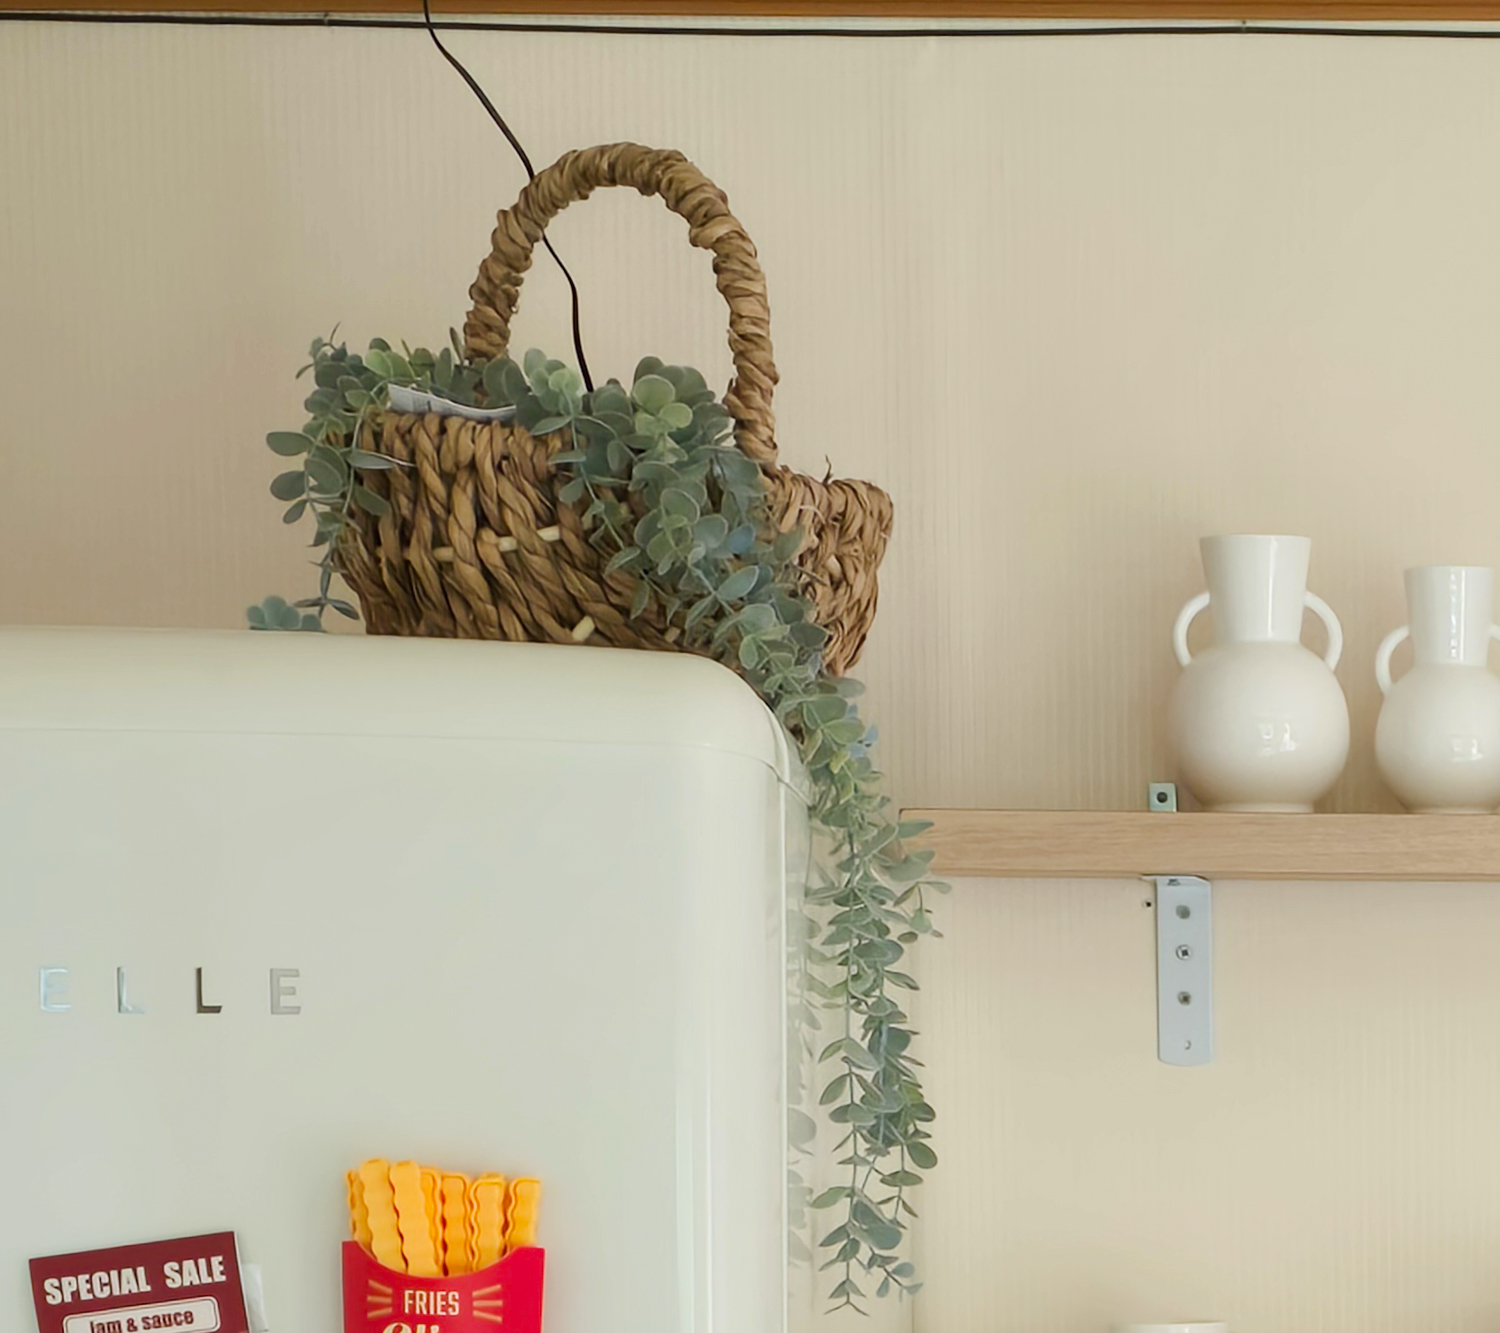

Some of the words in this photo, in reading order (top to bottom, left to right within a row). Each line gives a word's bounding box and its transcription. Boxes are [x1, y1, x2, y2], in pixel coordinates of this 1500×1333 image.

[39, 966, 301, 1015] ELLE
[44, 1266, 151, 1305] SPECIAL
[163, 1255, 226, 1289] SALE
[127, 1318, 137, 1332] &
[142, 1310, 194, 1330] sauce
[404, 1290, 459, 1316] FRIES
